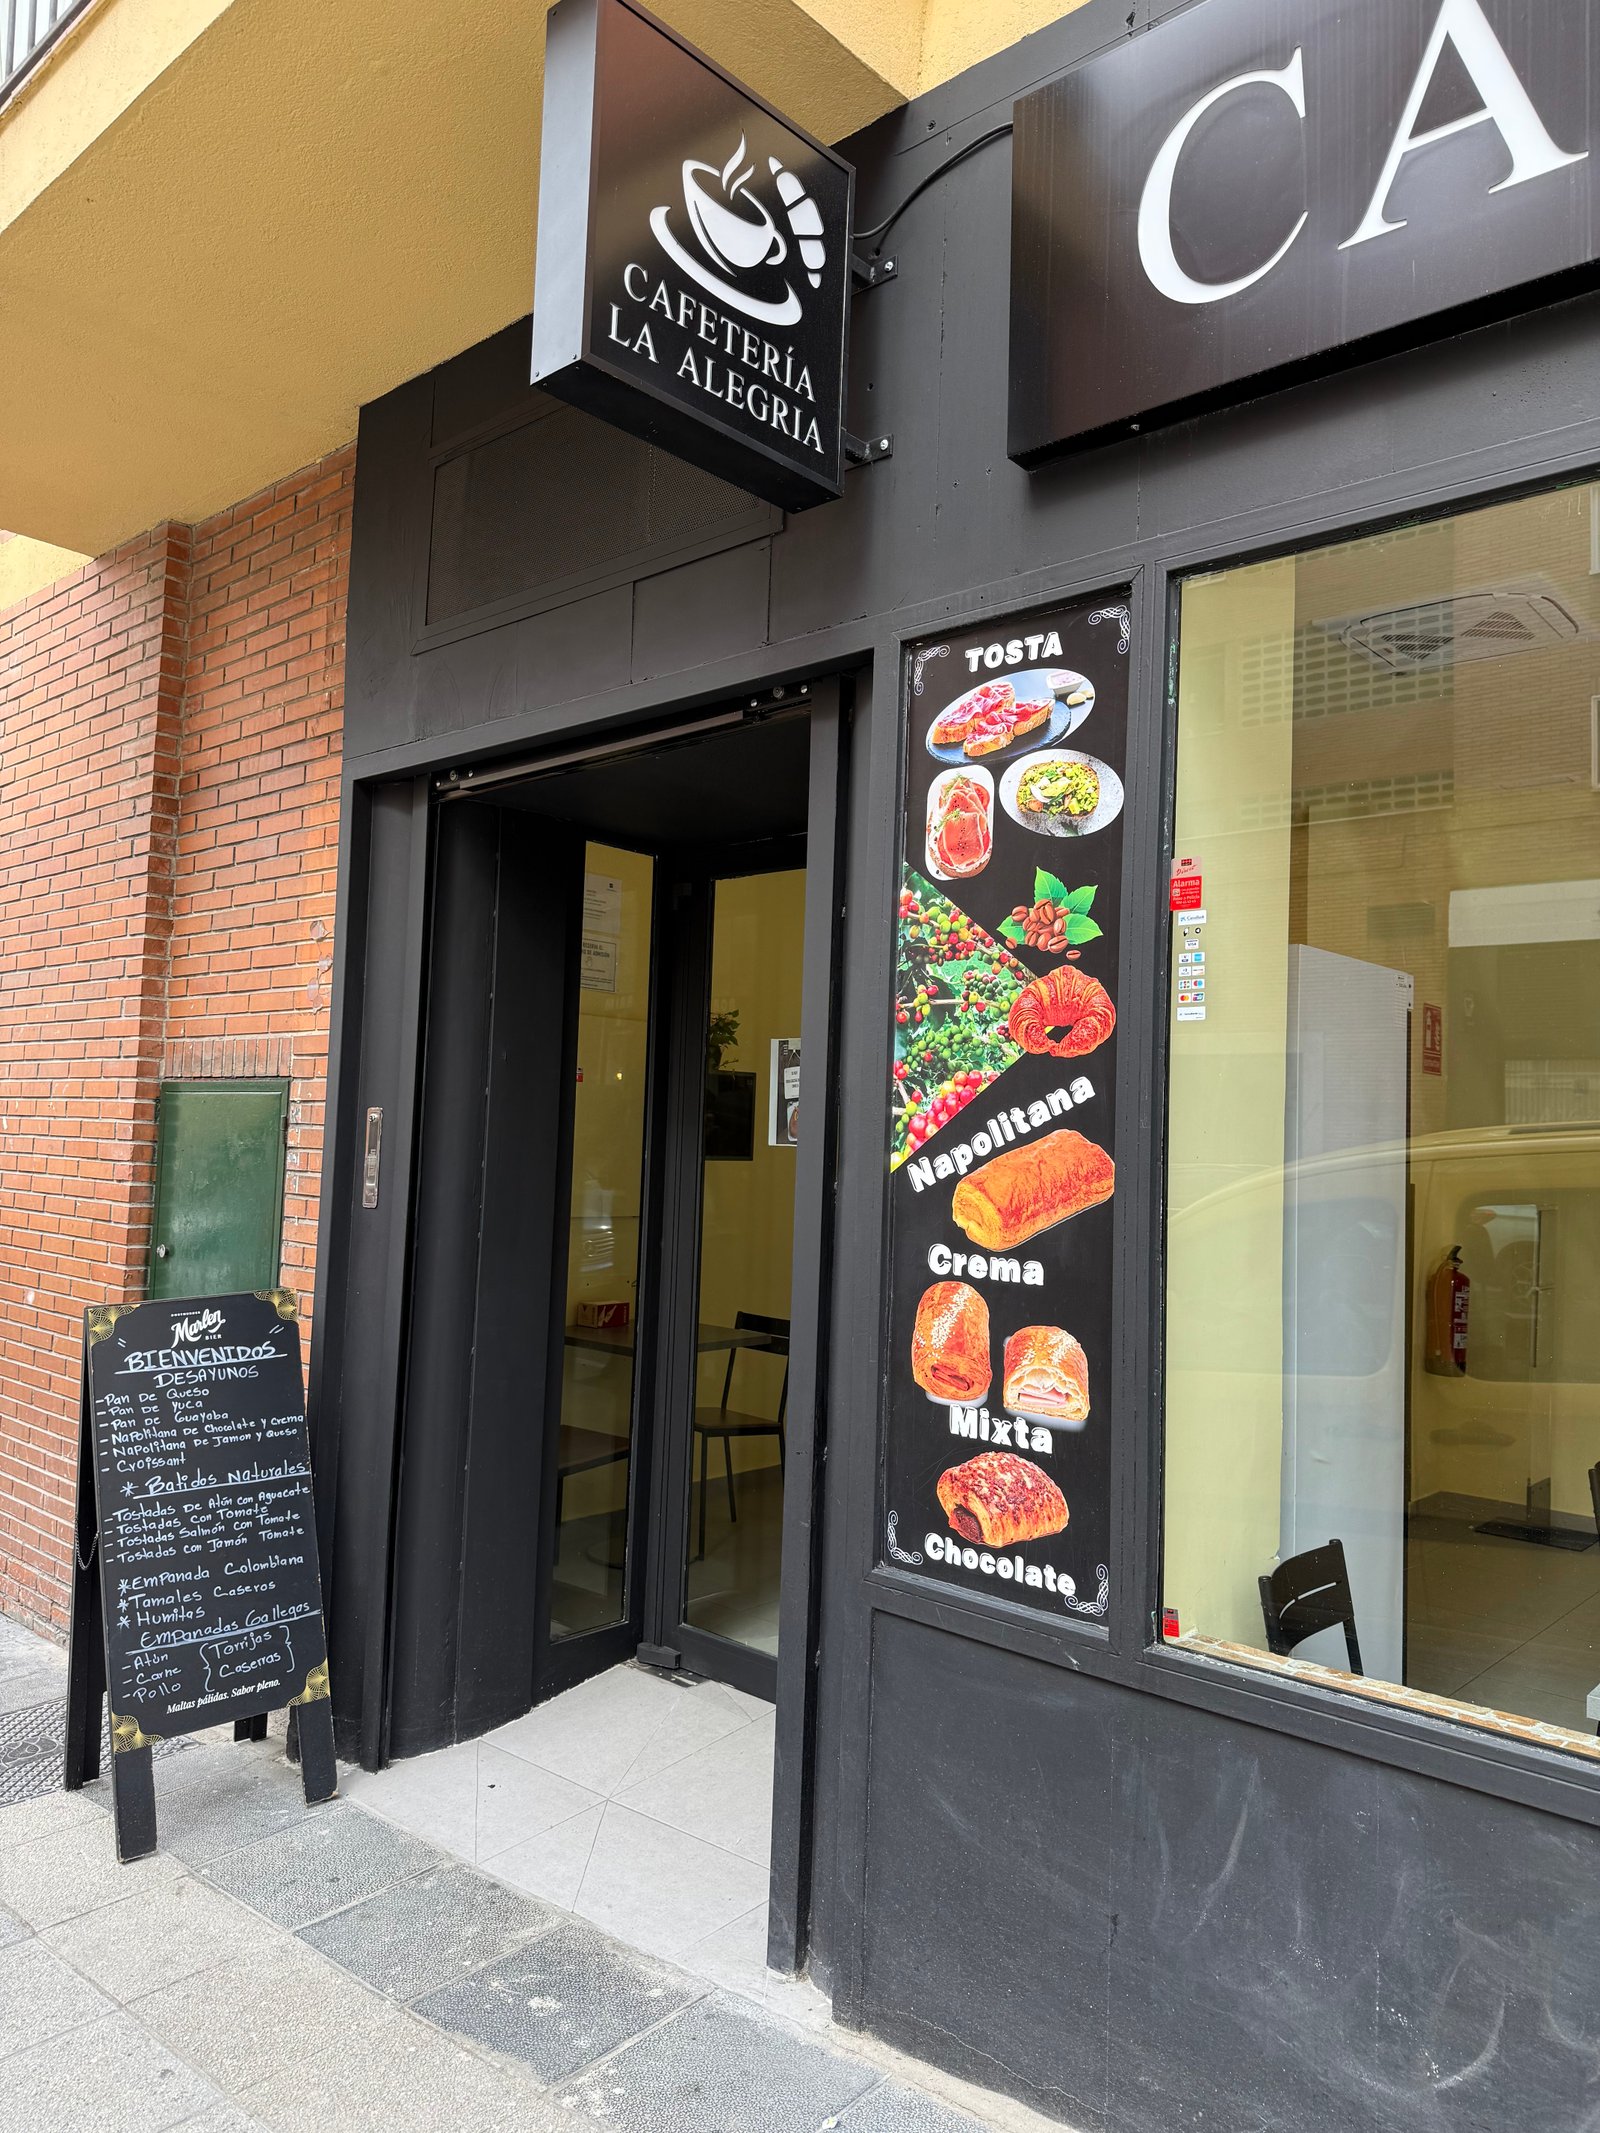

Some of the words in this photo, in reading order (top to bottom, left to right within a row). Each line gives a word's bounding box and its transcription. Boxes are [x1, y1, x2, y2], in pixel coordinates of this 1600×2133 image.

[1138, 0, 1589, 304] CA
[623, 262, 817, 403] CAFETERÍA
[608, 302, 660, 364] LA
[676, 347, 825, 454] ALEGRIA
[965, 631, 1063, 673] TOSTA
[1173, 879, 1200, 888] Alarma
[906, 1076, 1096, 1193] Napolitana
[928, 1243, 1045, 1286] Crema
[170, 1308, 227, 1349] Marlen
[205, 1333, 222, 1341] BIER
[123, 1340, 276, 1372] BIENVENIDOS
[153, 1365, 259, 1388] DESAYUNOS
[166, 1387, 210, 1400] Queso
[949, 1404, 1053, 1454] Mixta
[117, 1452, 186, 1472] Croissant
[145, 1468, 217, 1495] Batidos
[228, 1459, 306, 1483] Naturales
[112, 1501, 176, 1522] Tostadas
[258, 1482, 310, 1504] Aguacate
[116, 1518, 181, 1535] Tostadas
[217, 1503, 268, 1520] Tomate
[117, 1530, 175, 1547] Tostadas
[179, 1522, 225, 1539] Salmón
[256, 1510, 300, 1525] Tomate
[117, 1544, 177, 1563] Tostadas
[207, 1533, 247, 1553] Jamón
[258, 1526, 304, 1542] Tomate
[224, 1554, 304, 1576] Colombiana
[924, 1533, 1076, 1596] Chocolate
[128, 1589, 202, 1609] Tamales
[213, 1581, 276, 1597] Caseros
[136, 1606, 206, 1627] Humitas
[245, 1602, 310, 1627] Gallegas
[208, 1631, 272, 1659] Torrijas
[134, 1653, 168, 1670] Atún
[136, 1668, 181, 1684] Carne
[132, 1682, 181, 1703] Pollo
[166, 1700, 195, 1714] Maltas
[197, 1692, 229, 1708] pálidas.
[231, 1684, 255, 1698] Sabor
[257, 1679, 280, 1693] pleno.
